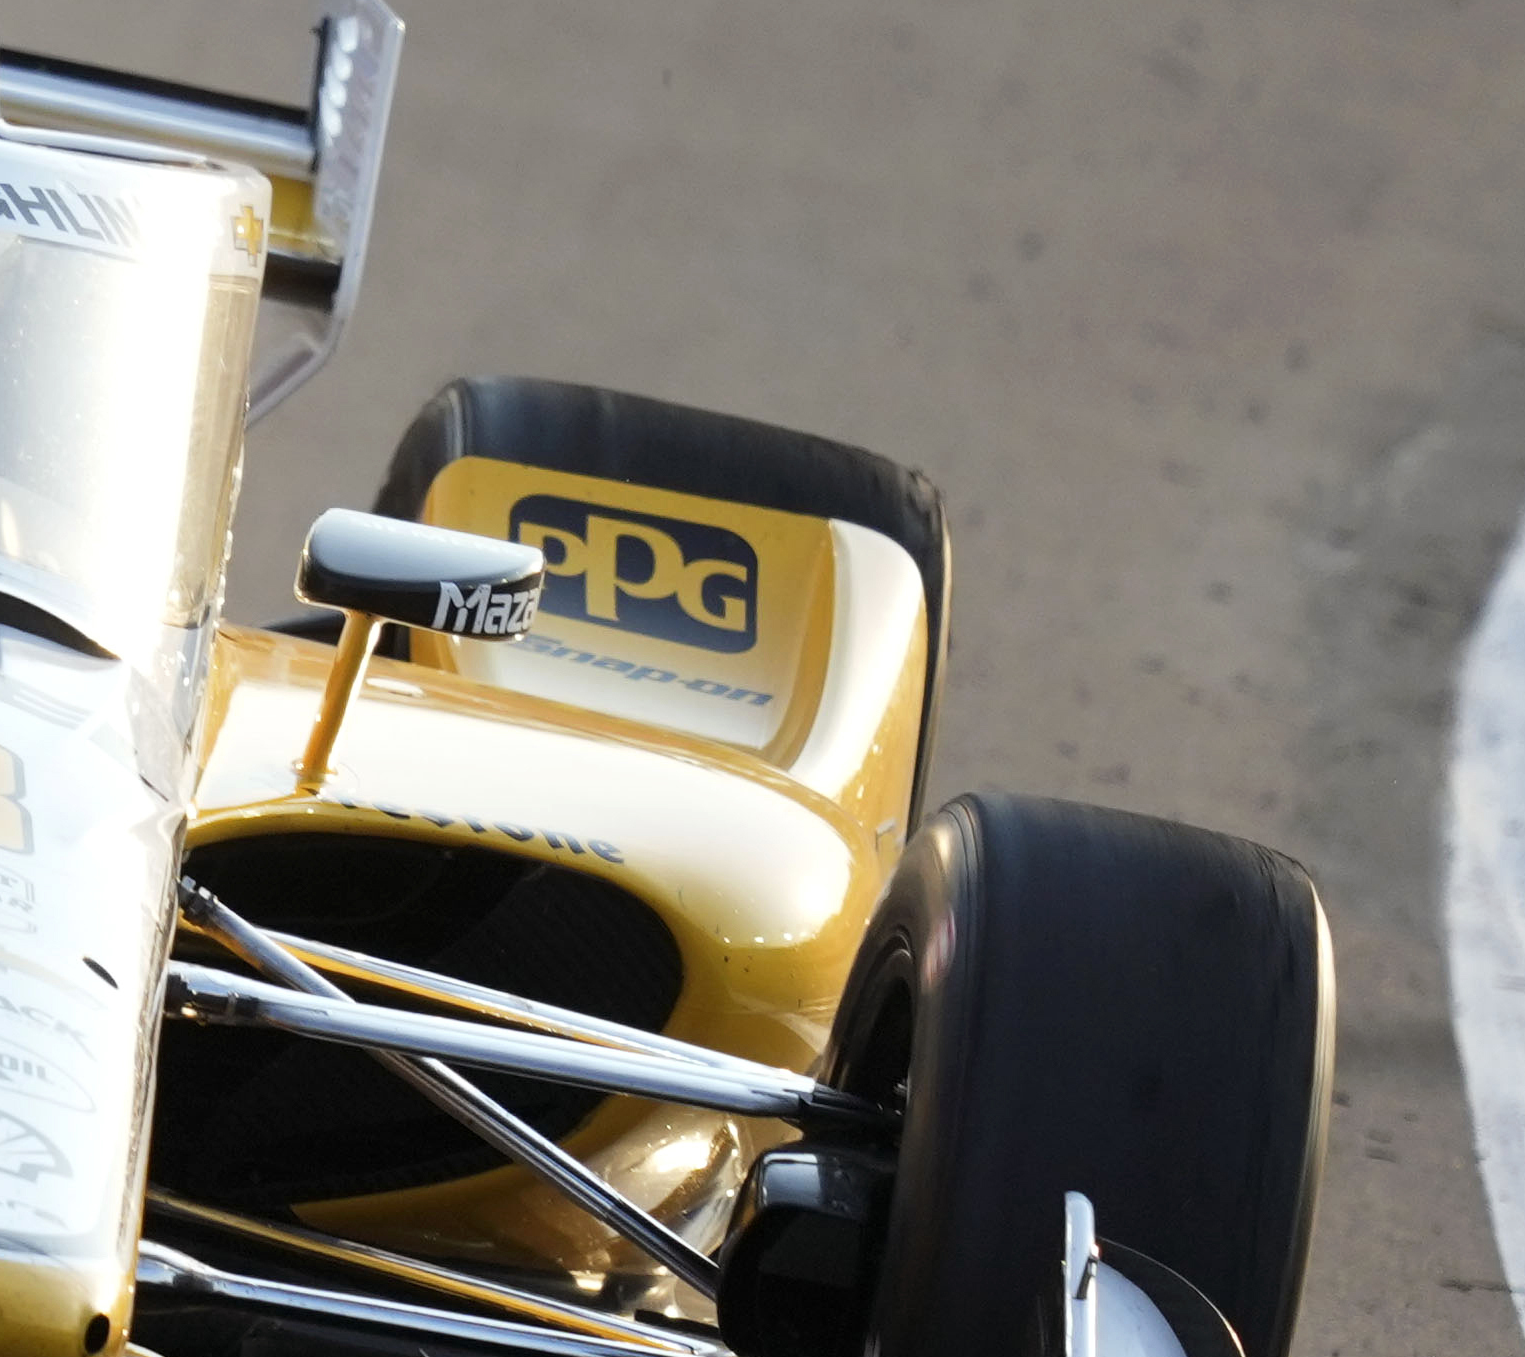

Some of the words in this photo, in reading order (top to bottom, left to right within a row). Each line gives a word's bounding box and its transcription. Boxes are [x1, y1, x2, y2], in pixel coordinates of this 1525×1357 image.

[431, 580, 542, 635] Maza
[520, 512, 749, 634] PPG
[511, 634, 774, 697] Snap-on
[301, 787, 625, 865] restone
